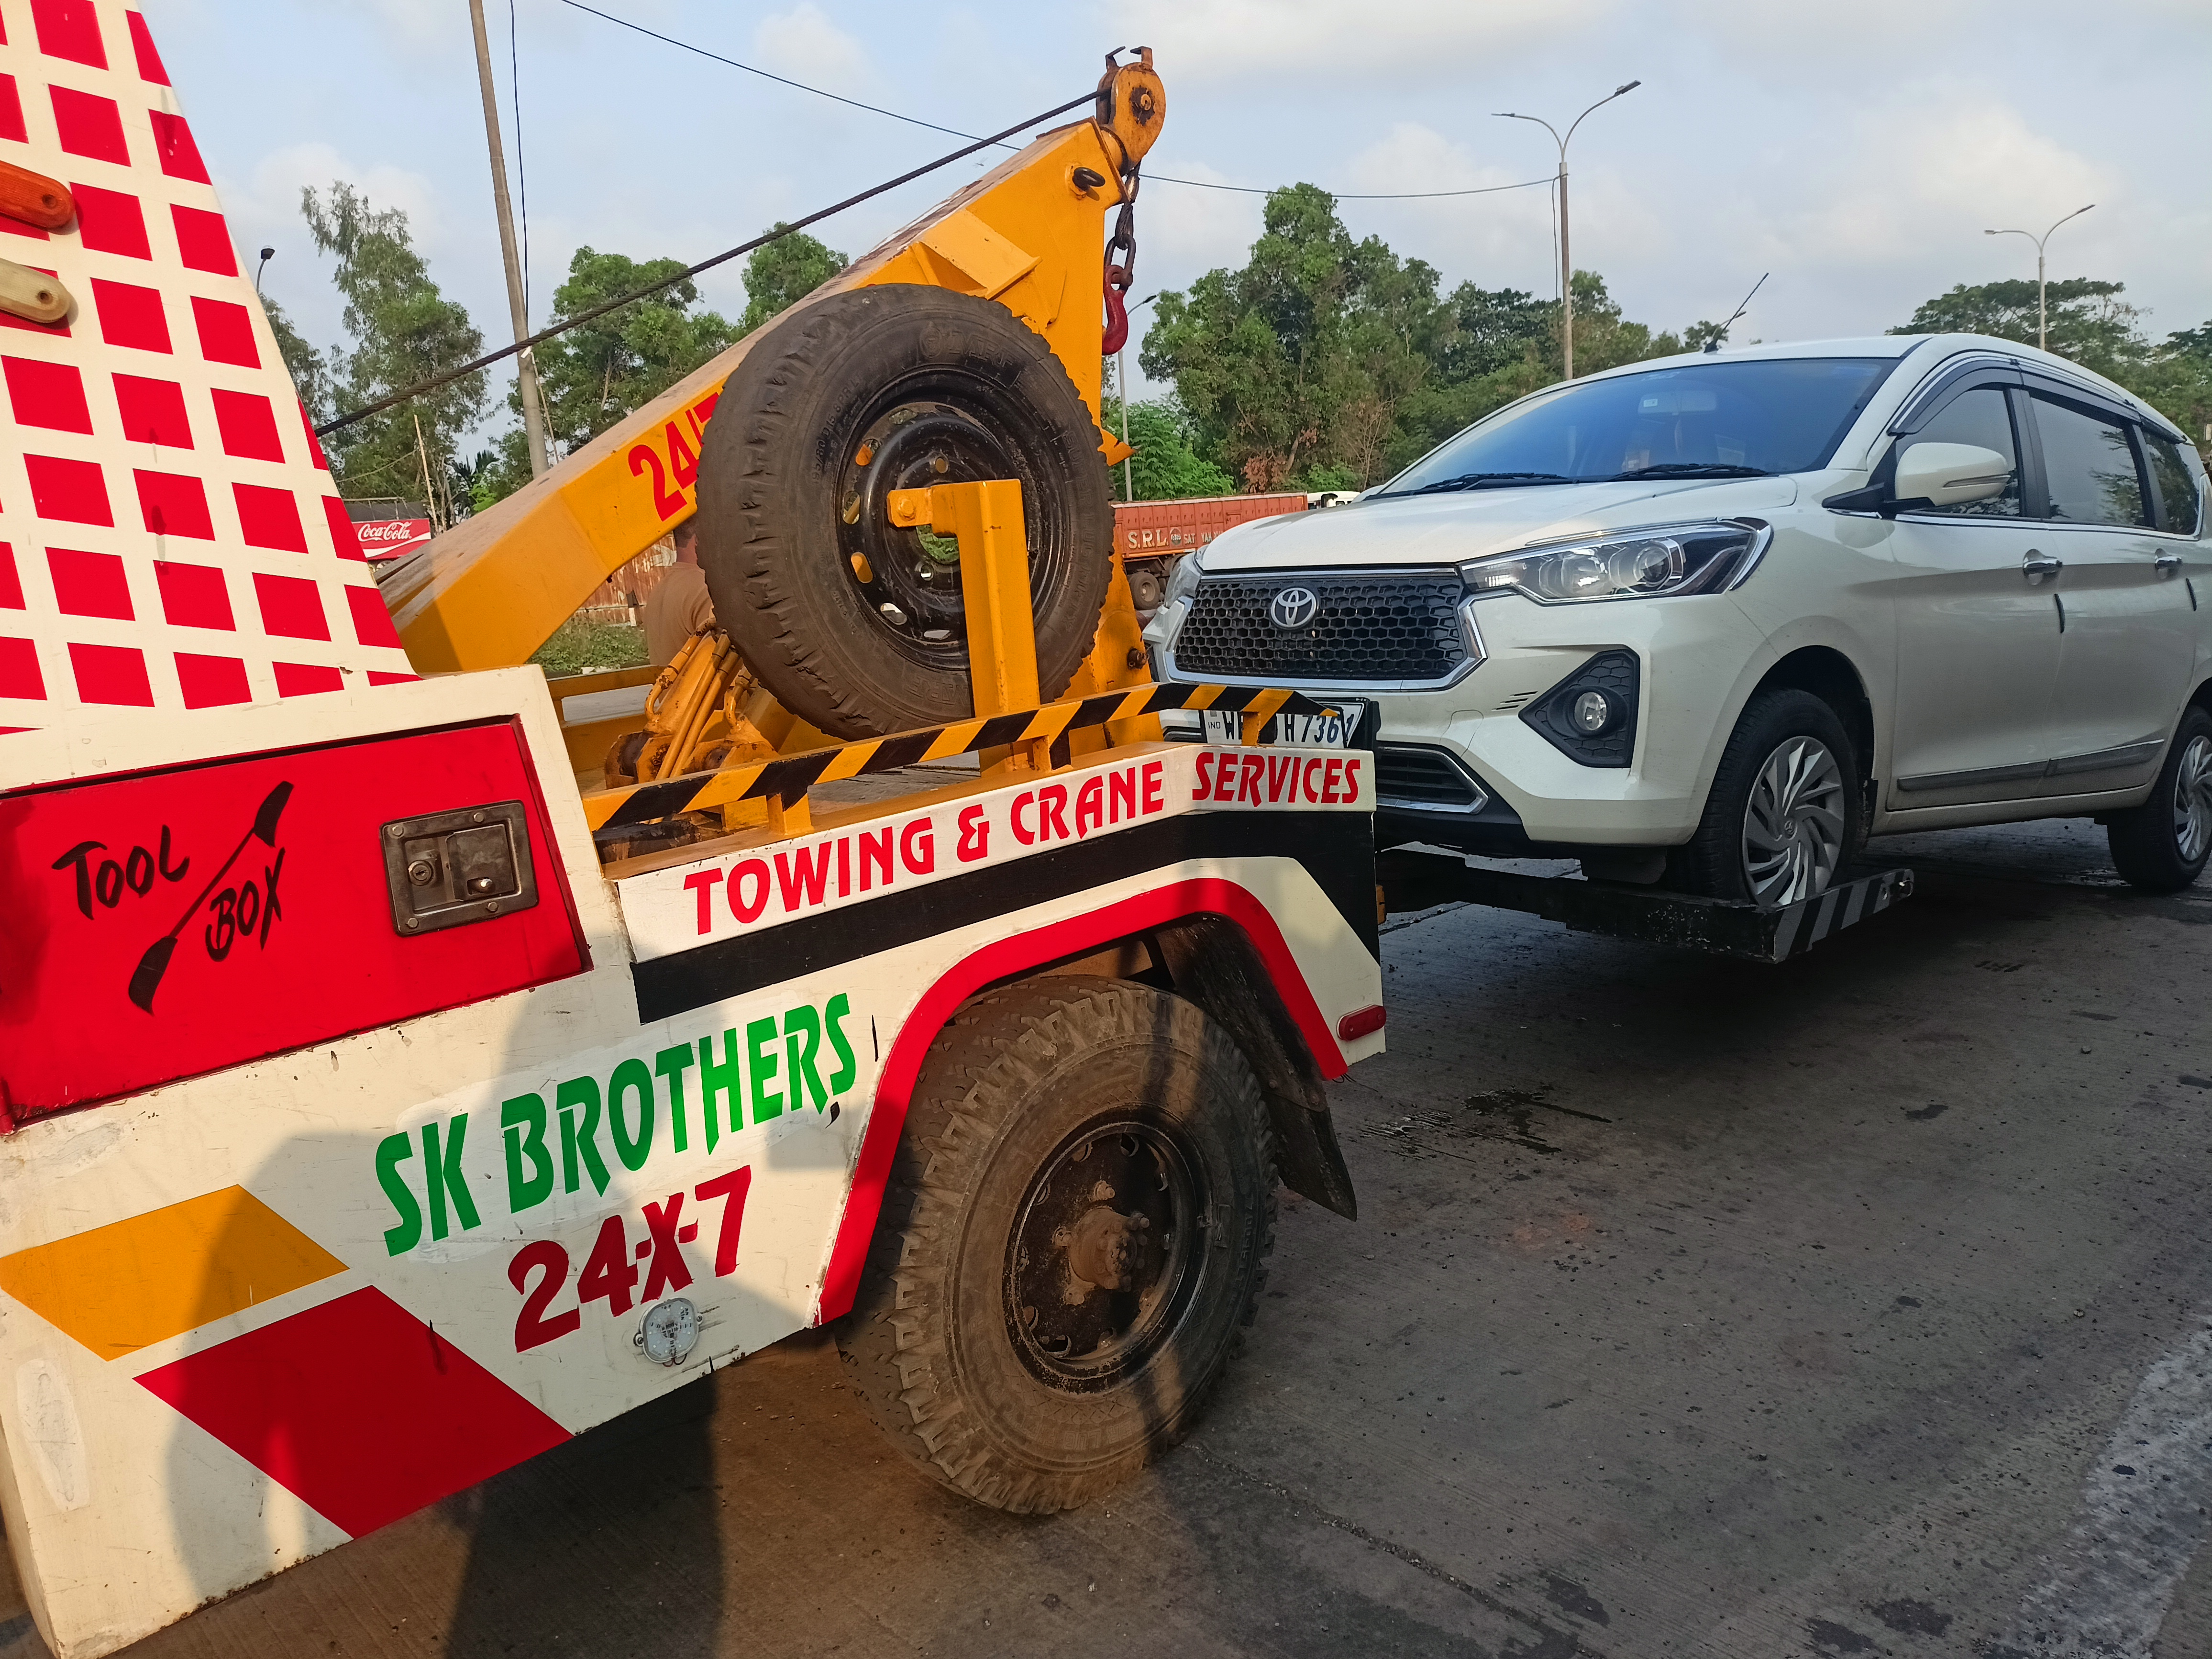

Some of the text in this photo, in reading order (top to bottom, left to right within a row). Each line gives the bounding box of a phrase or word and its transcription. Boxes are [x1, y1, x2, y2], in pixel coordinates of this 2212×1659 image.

[358, 521, 412, 542] Coca-Cola
[1128, 529, 1169, 549] S.R.L.
[1208, 721, 1221, 730] IND
[52, 826, 189, 920] TOOL
[684, 752, 1360, 935] TOWING & CRANE SERVICES
[206, 847, 285, 962] BOX
[376, 993, 856, 1257] SK BROTHERS
